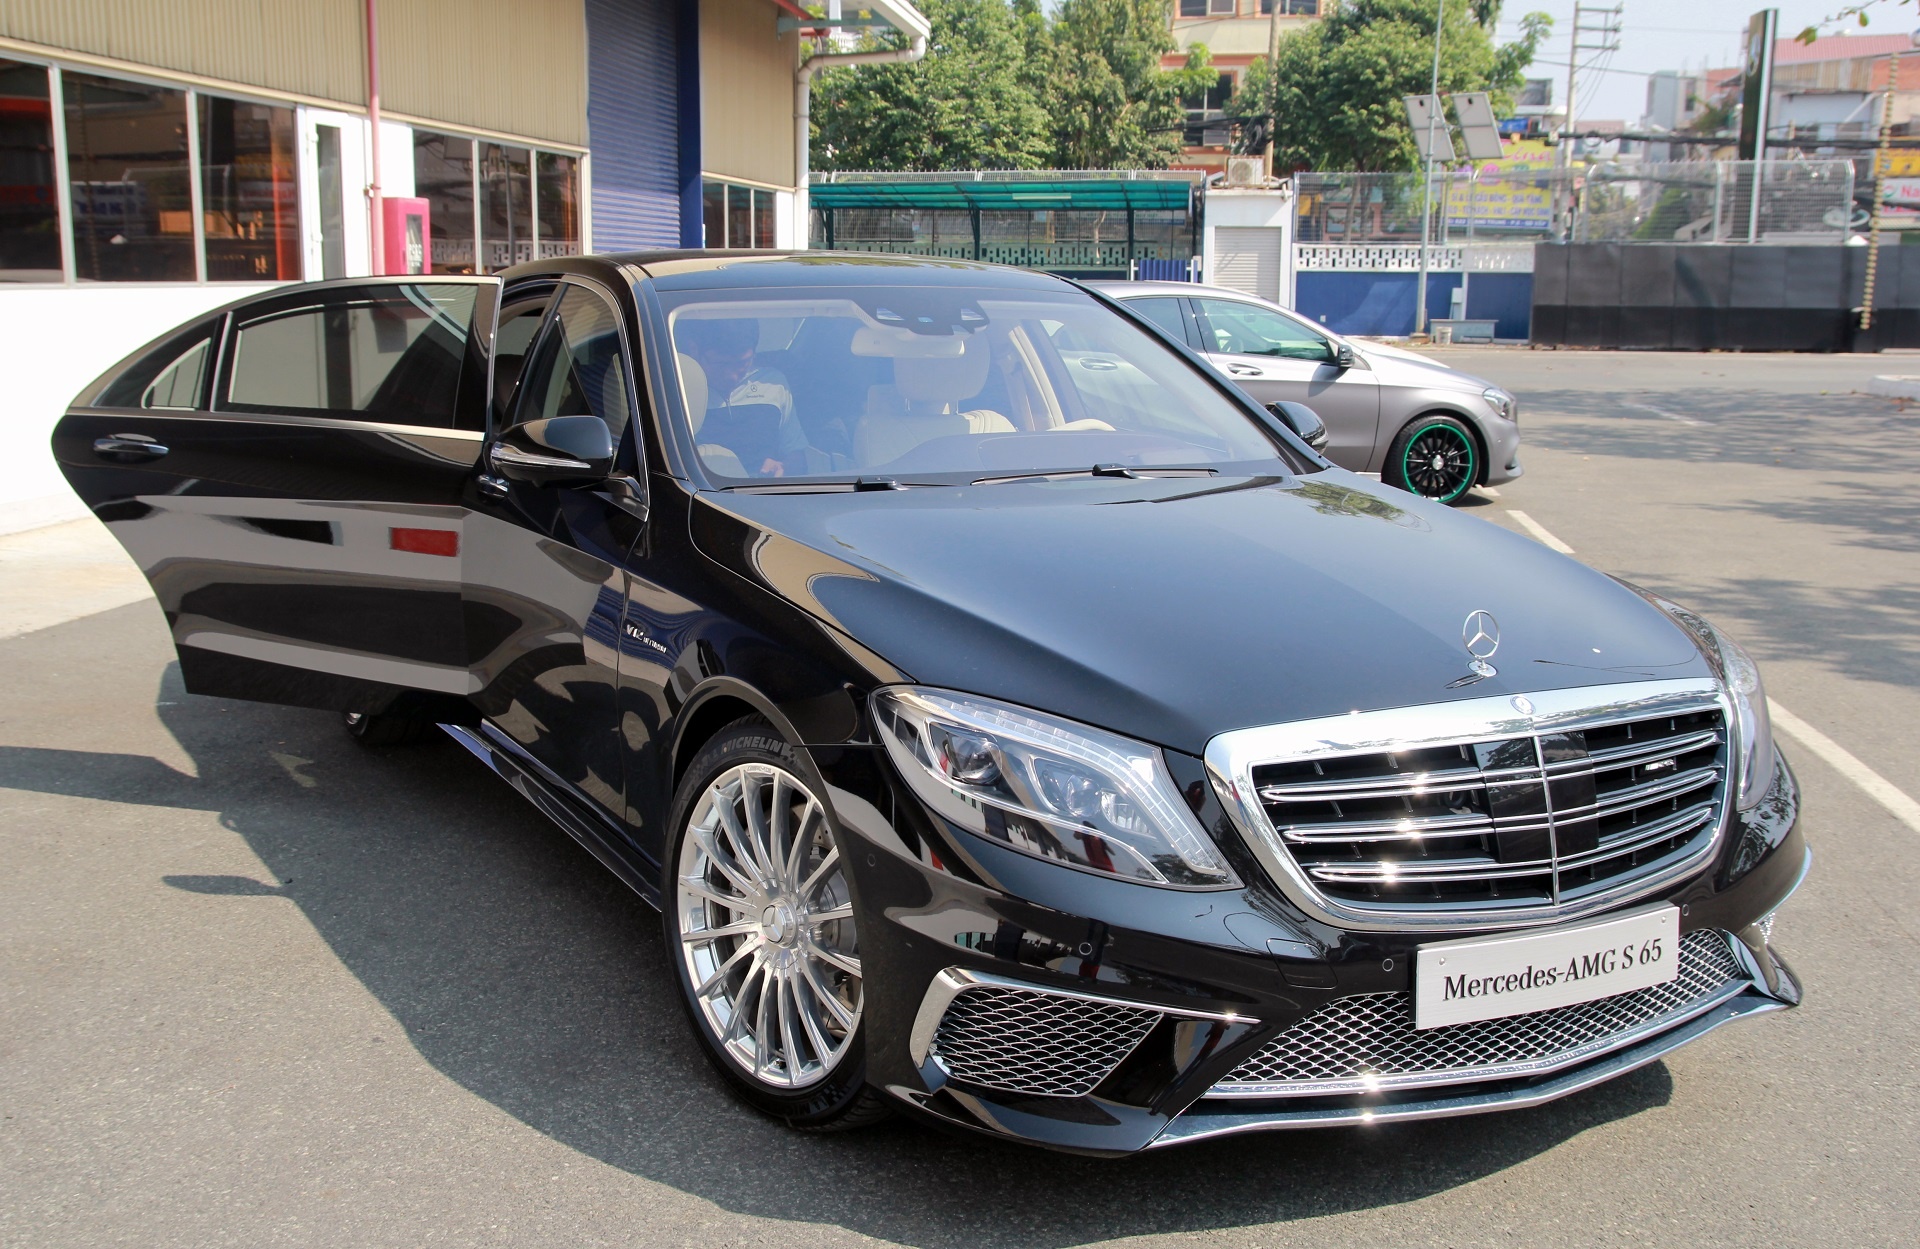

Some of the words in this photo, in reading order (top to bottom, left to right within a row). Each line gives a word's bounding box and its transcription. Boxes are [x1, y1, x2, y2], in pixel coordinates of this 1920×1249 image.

[721, 736, 783, 755] MICHELIN
[1442, 948, 1617, 1002] Mercedes-AMG
[1621, 944, 1635, 970] S
[1639, 938, 1662, 965] 65
